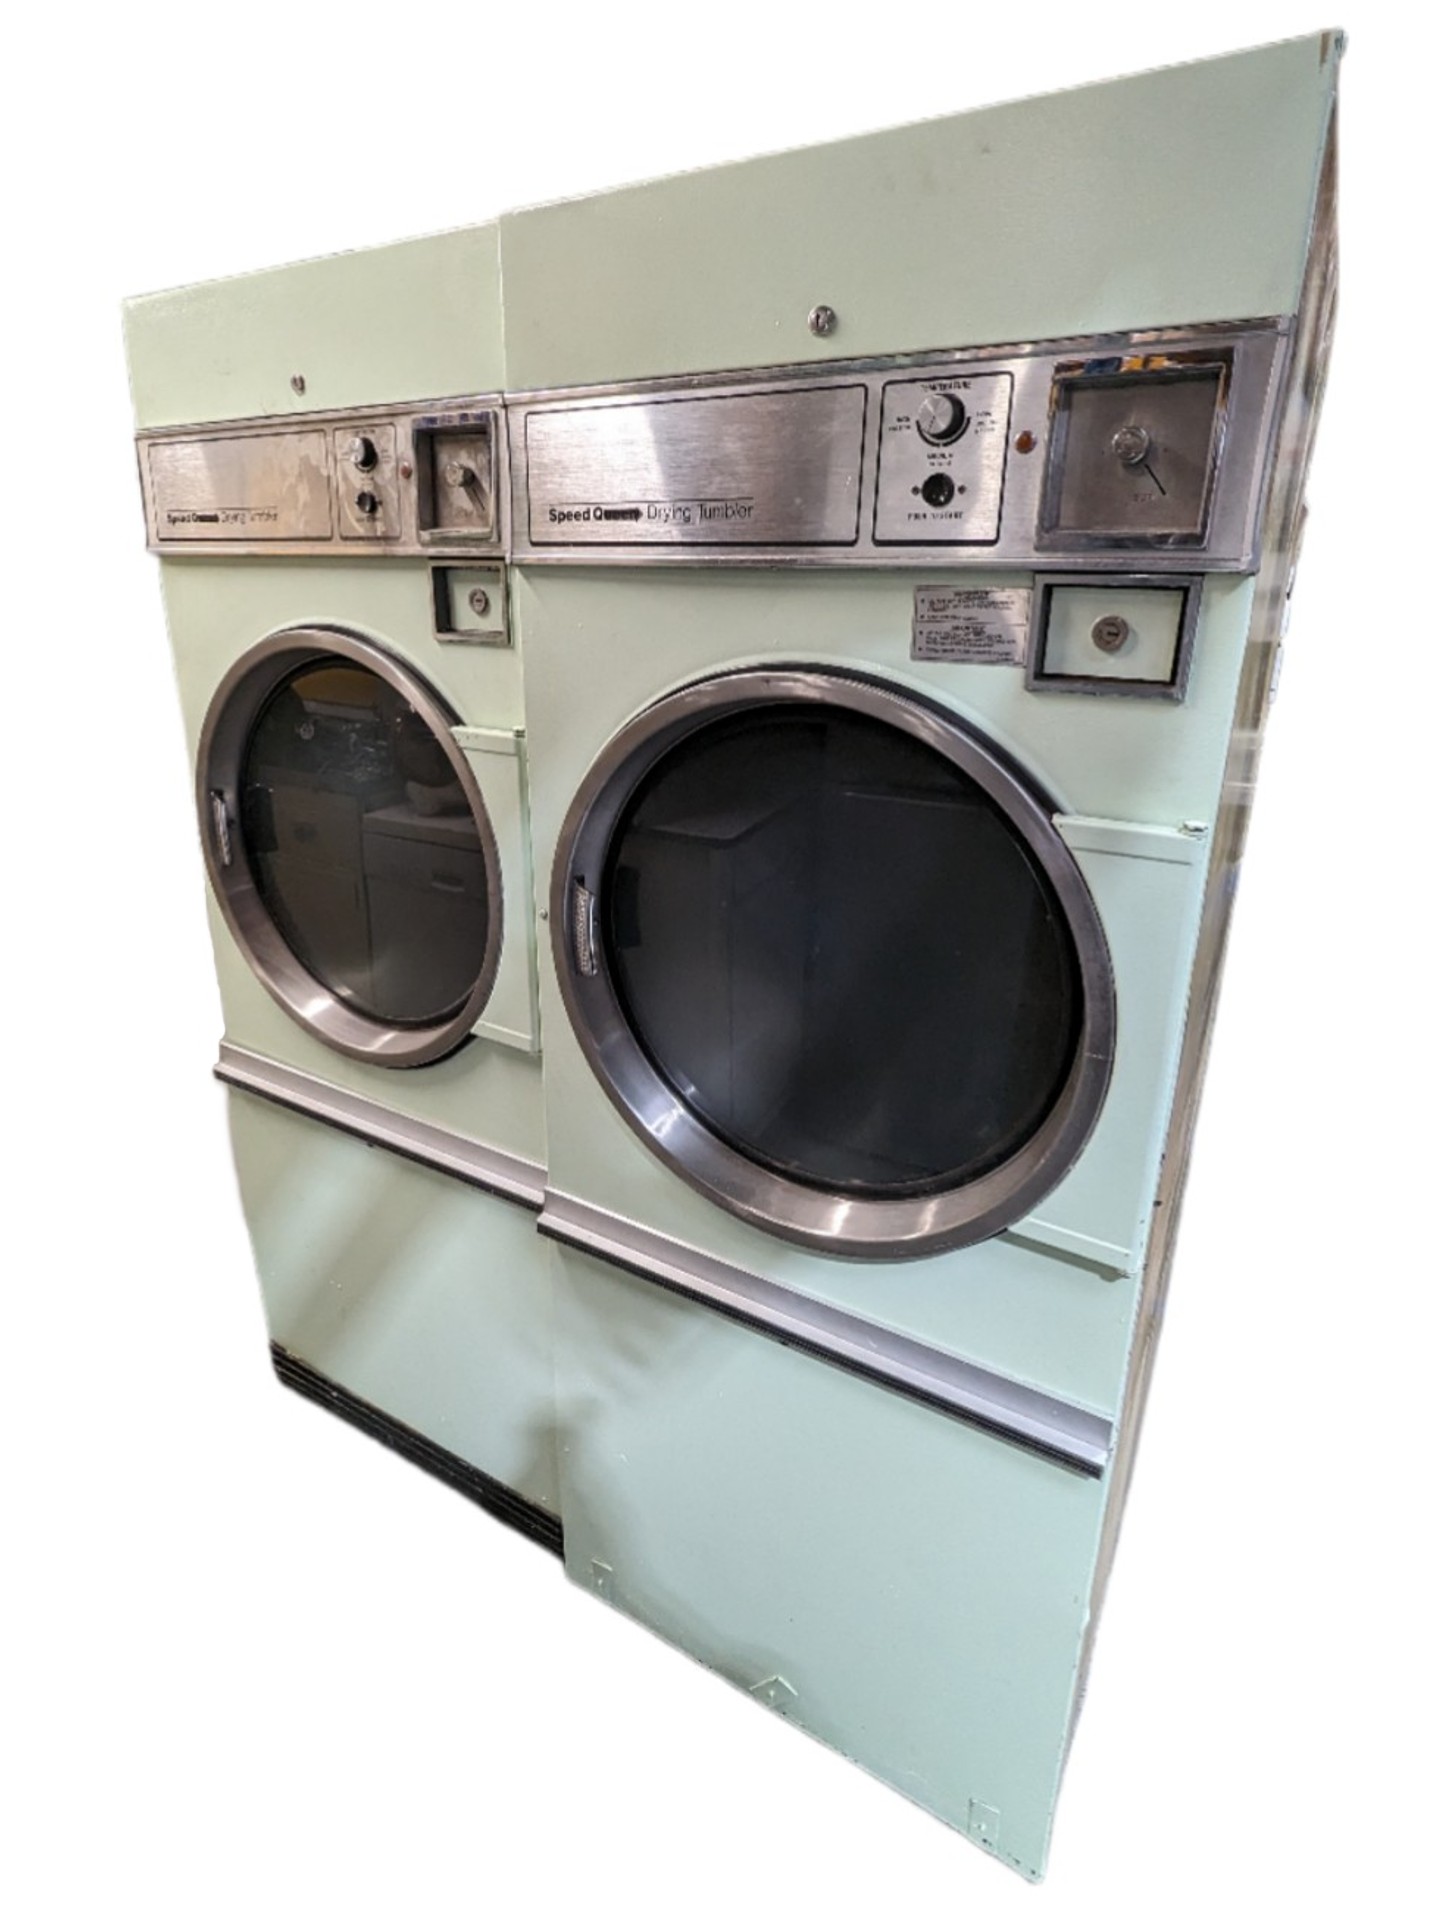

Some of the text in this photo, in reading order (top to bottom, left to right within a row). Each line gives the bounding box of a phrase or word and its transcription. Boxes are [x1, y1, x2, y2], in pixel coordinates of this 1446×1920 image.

[549, 507, 591, 524] Speed
[647, 504, 692, 523] Drying
[699, 502, 754, 519] Tumbler
